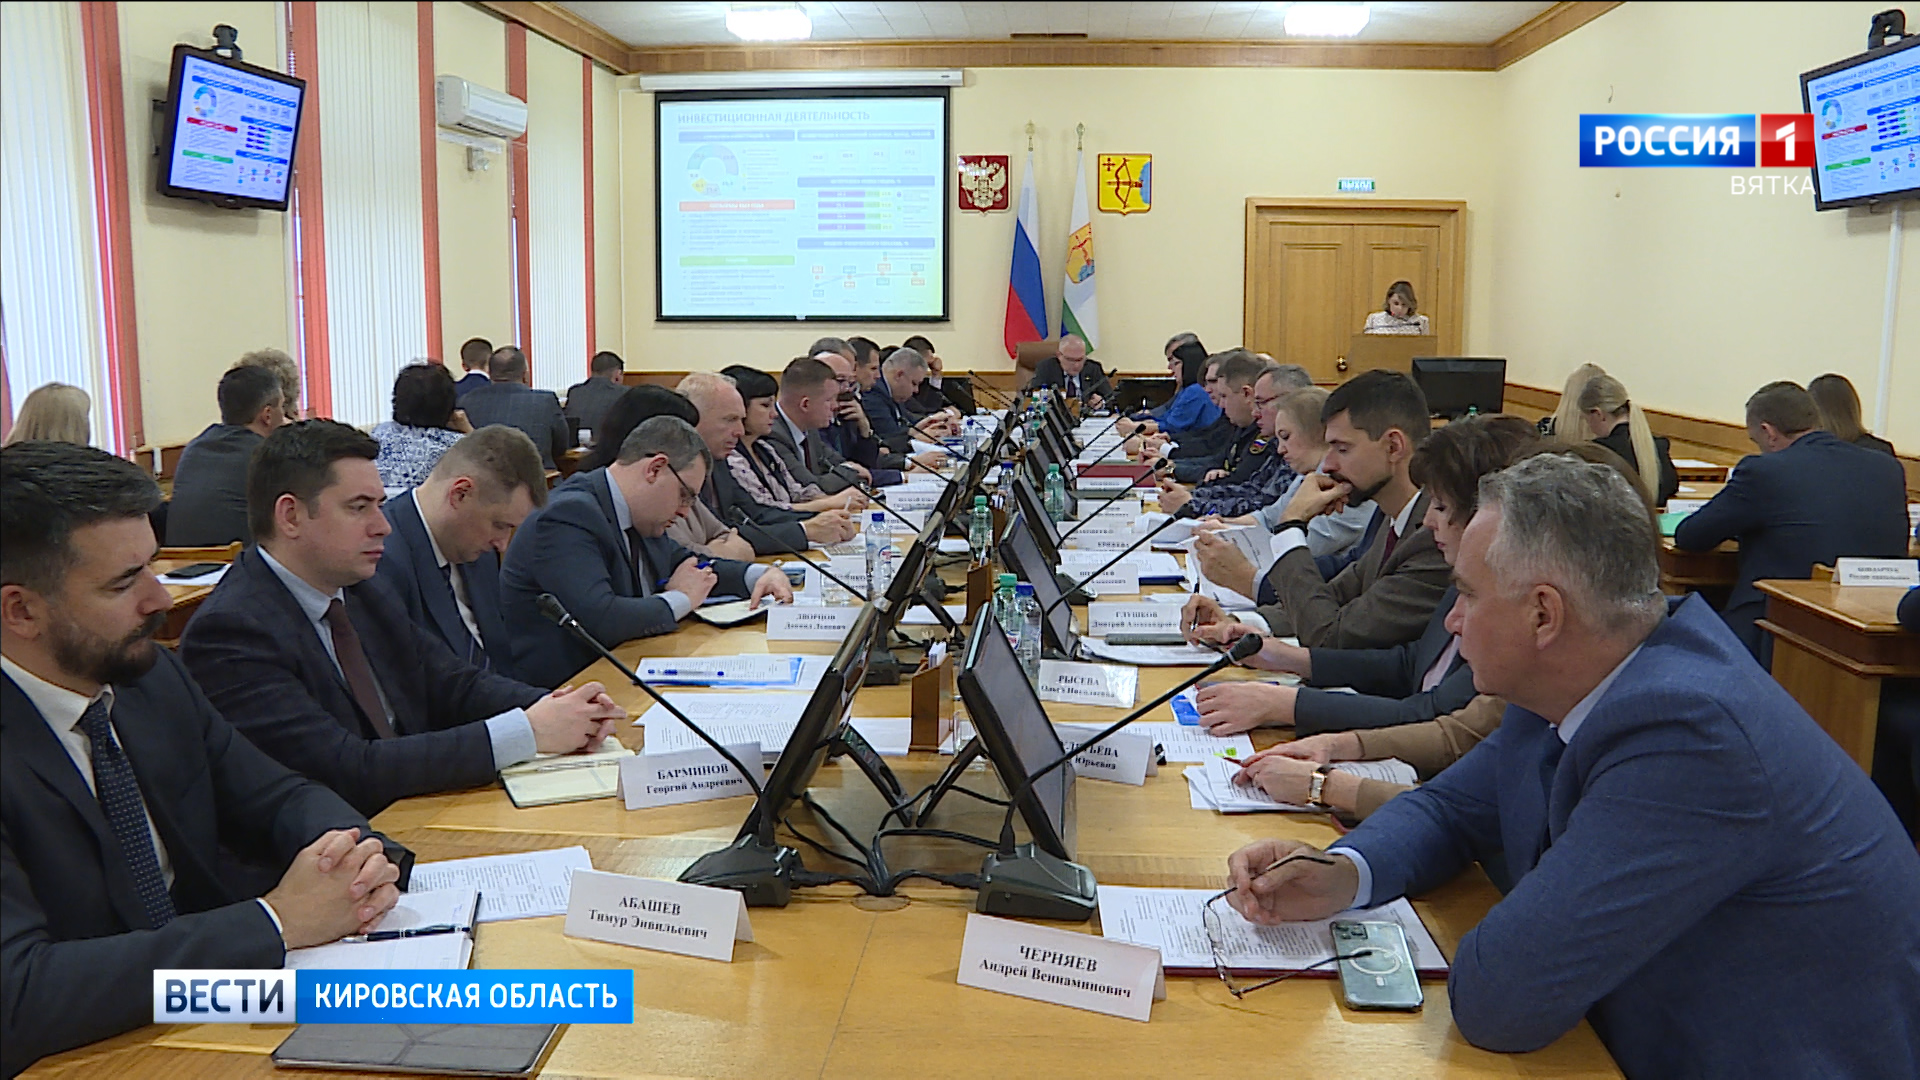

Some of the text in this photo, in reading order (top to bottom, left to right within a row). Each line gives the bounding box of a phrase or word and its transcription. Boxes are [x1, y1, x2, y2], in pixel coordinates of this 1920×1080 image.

[677, 111, 870, 123] ИНВЕСТИЦИОННАЯ ДЕЯТЕЛЬНОСТЬ
[1342, 180, 1371, 190] ВЫХОД
[1058, 674, 1100, 686] РЫСЕВА
[657, 763, 729, 780] БАРМИНОВ
[646, 777, 743, 796] Георгий Андреевич
[619, 896, 681, 916] АБАШЕВ
[588, 908, 708, 940] Тимур Энвильевич
[1020, 945, 1098, 972] ЧЕРНЯЕВ
[979, 959, 1132, 998] Андрей Вениаминович
